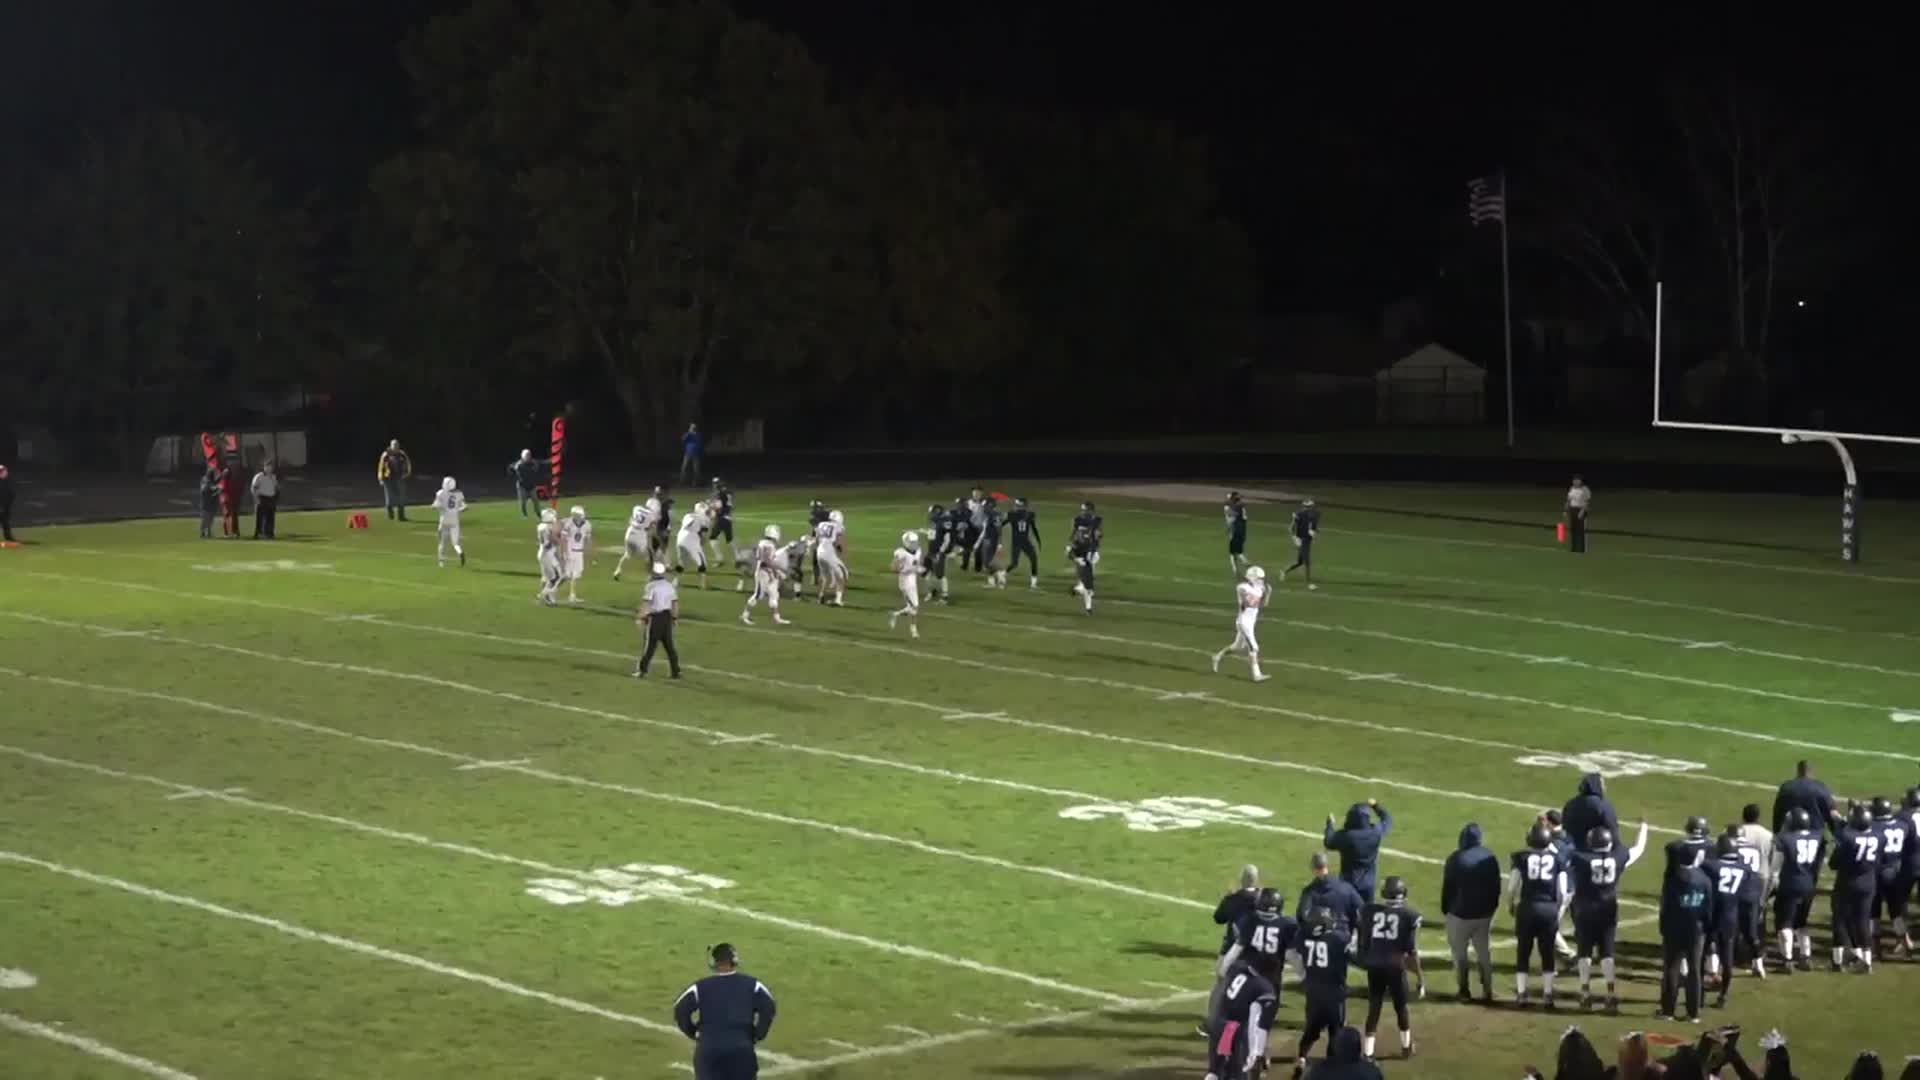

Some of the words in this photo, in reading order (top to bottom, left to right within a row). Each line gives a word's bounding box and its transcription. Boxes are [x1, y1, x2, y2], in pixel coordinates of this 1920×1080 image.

[1841, 488, 1854, 560] HAWKS
[1855, 836, 1879, 861] 72
[1527, 854, 1556, 881] 62
[1589, 858, 1617, 885] 53
[1718, 868, 1744, 894] 27
[1250, 925, 1279, 954] 45
[1371, 912, 1400, 940] 23
[1304, 940, 1329, 968] 79
[1226, 973, 1247, 1000] 9
